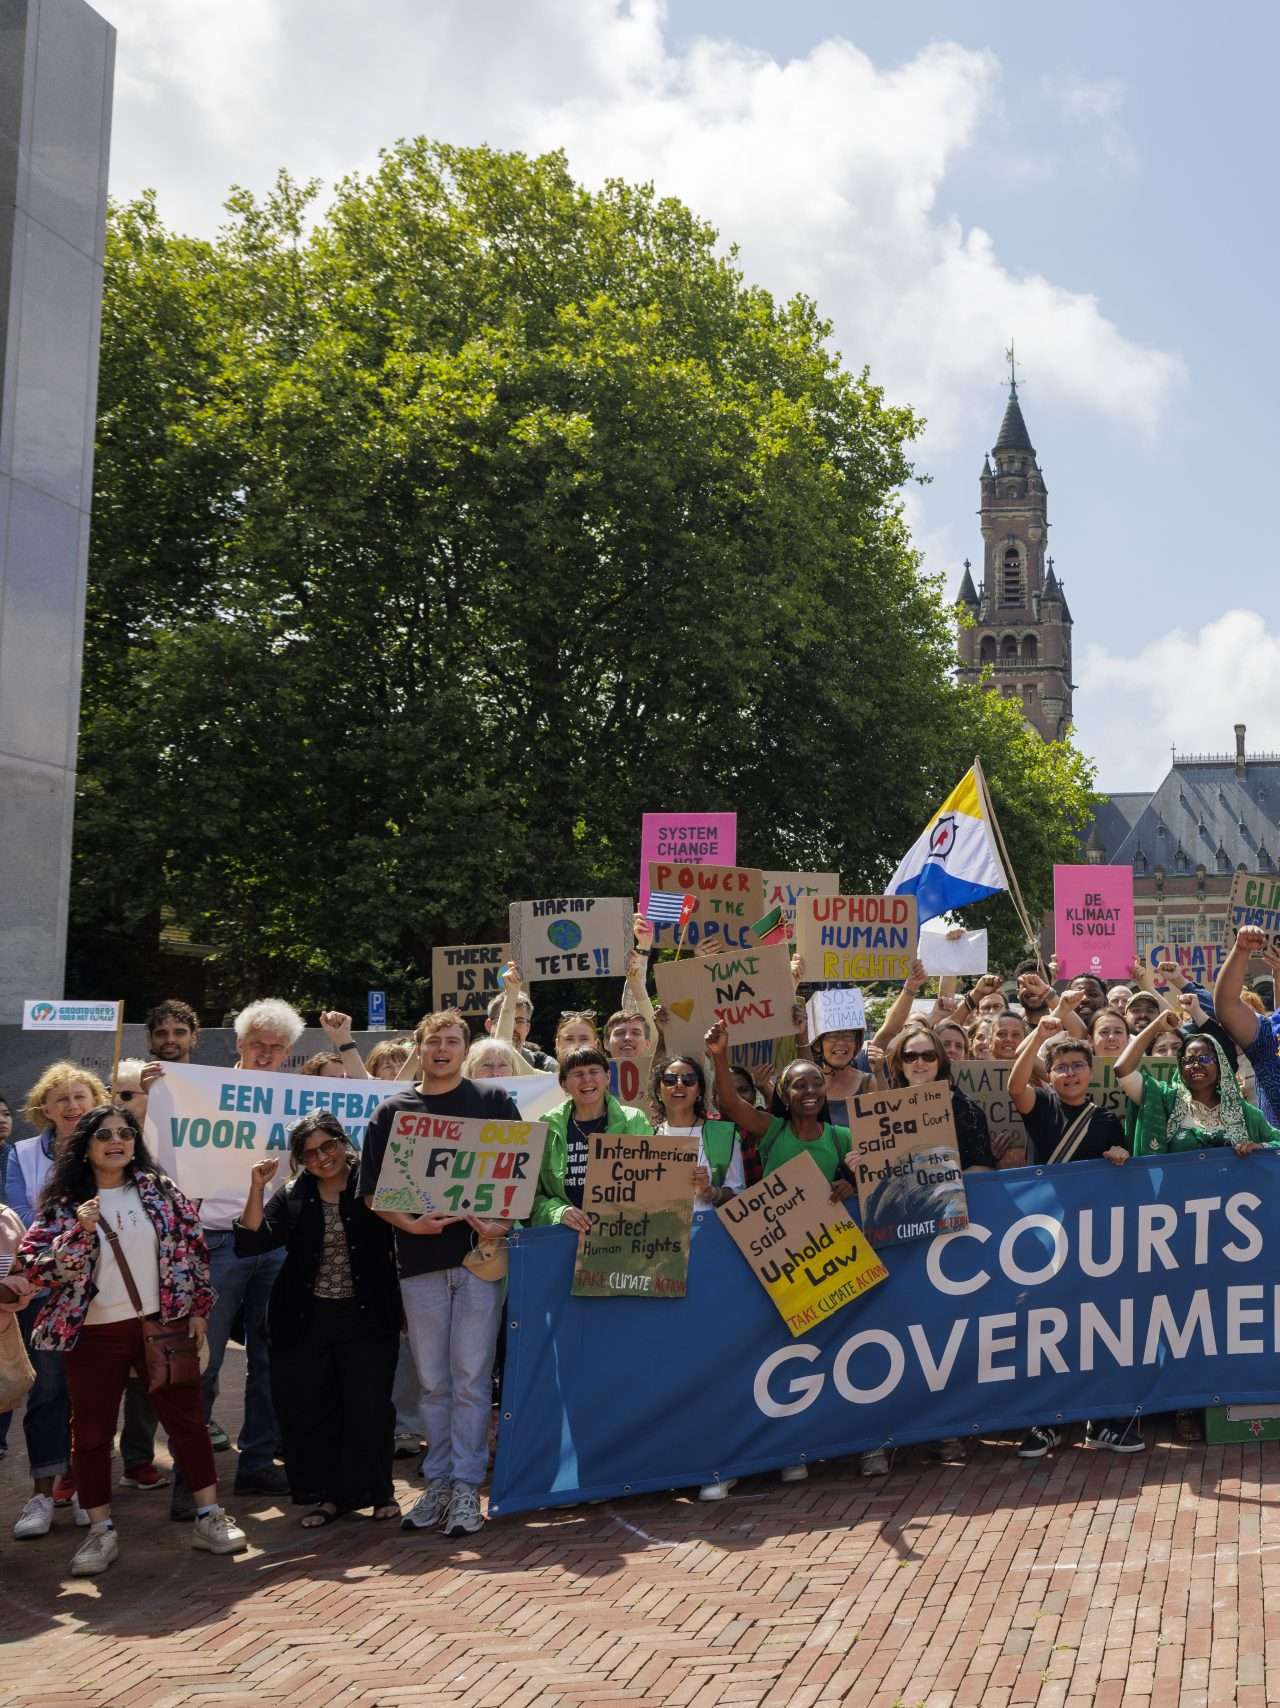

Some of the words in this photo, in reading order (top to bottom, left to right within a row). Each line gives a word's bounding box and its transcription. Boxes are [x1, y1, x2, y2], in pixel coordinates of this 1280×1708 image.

[658, 826, 718, 841] SYSTEM
[657, 842, 718, 856] CHANGE
[656, 865, 750, 892] POWER
[709, 899, 744, 916] THE
[812, 897, 909, 924] UPHOLD
[1084, 893, 1102, 906] DE
[1066, 908, 1121, 921] KLIMAAT
[820, 925, 909, 950] HUMAN
[1072, 923, 1084, 936] IS
[1087, 923, 1116, 936] VOL!
[444, 946, 503, 966] THERE
[457, 968, 477, 990] IS
[703, 956, 760, 983] YUMI
[373, 993, 382, 1011] P
[716, 980, 756, 1004] NA
[822, 990, 857, 1007] SOS
[713, 999, 775, 1027] YUMI
[219, 1083, 274, 1116] EEN
[854, 1096, 902, 1119] Law
[908, 1091, 919, 1105] of
[924, 1091, 942, 1104] the
[170, 1117, 258, 1150] VOOR
[396, 1115, 465, 1141] SAVE
[479, 1121, 533, 1146] OUR
[878, 1117, 918, 1138] Sea
[922, 1111, 950, 1128] Court
[858, 1135, 896, 1155] said
[425, 1147, 531, 1181] FUTUR
[611, 1162, 667, 1182] Court
[858, 1153, 915, 1184] Protect
[927, 1152, 950, 1166] the
[916, 1167, 962, 1187] Ocean
[591, 1180, 637, 1204] said
[724, 1173, 787, 1224] World
[763, 1186, 806, 1224] Court
[585, 1212, 651, 1237] Protect
[897, 1219, 936, 1239] CLIMATE
[583, 1240, 622, 1257] Human
[631, 1237, 682, 1260] Rights
[750, 1220, 787, 1258] said
[760, 1223, 835, 1285] Uphold
[834, 1218, 856, 1235] the
[926, 1190, 1265, 1296] COURTS
[804, 1244, 858, 1287] Law
[608, 1271, 652, 1291] CLIMATE
[788, 1307, 818, 1331] TAKE
[817, 1282, 857, 1314] CLIMATE
[856, 1263, 888, 1291] ACTION
